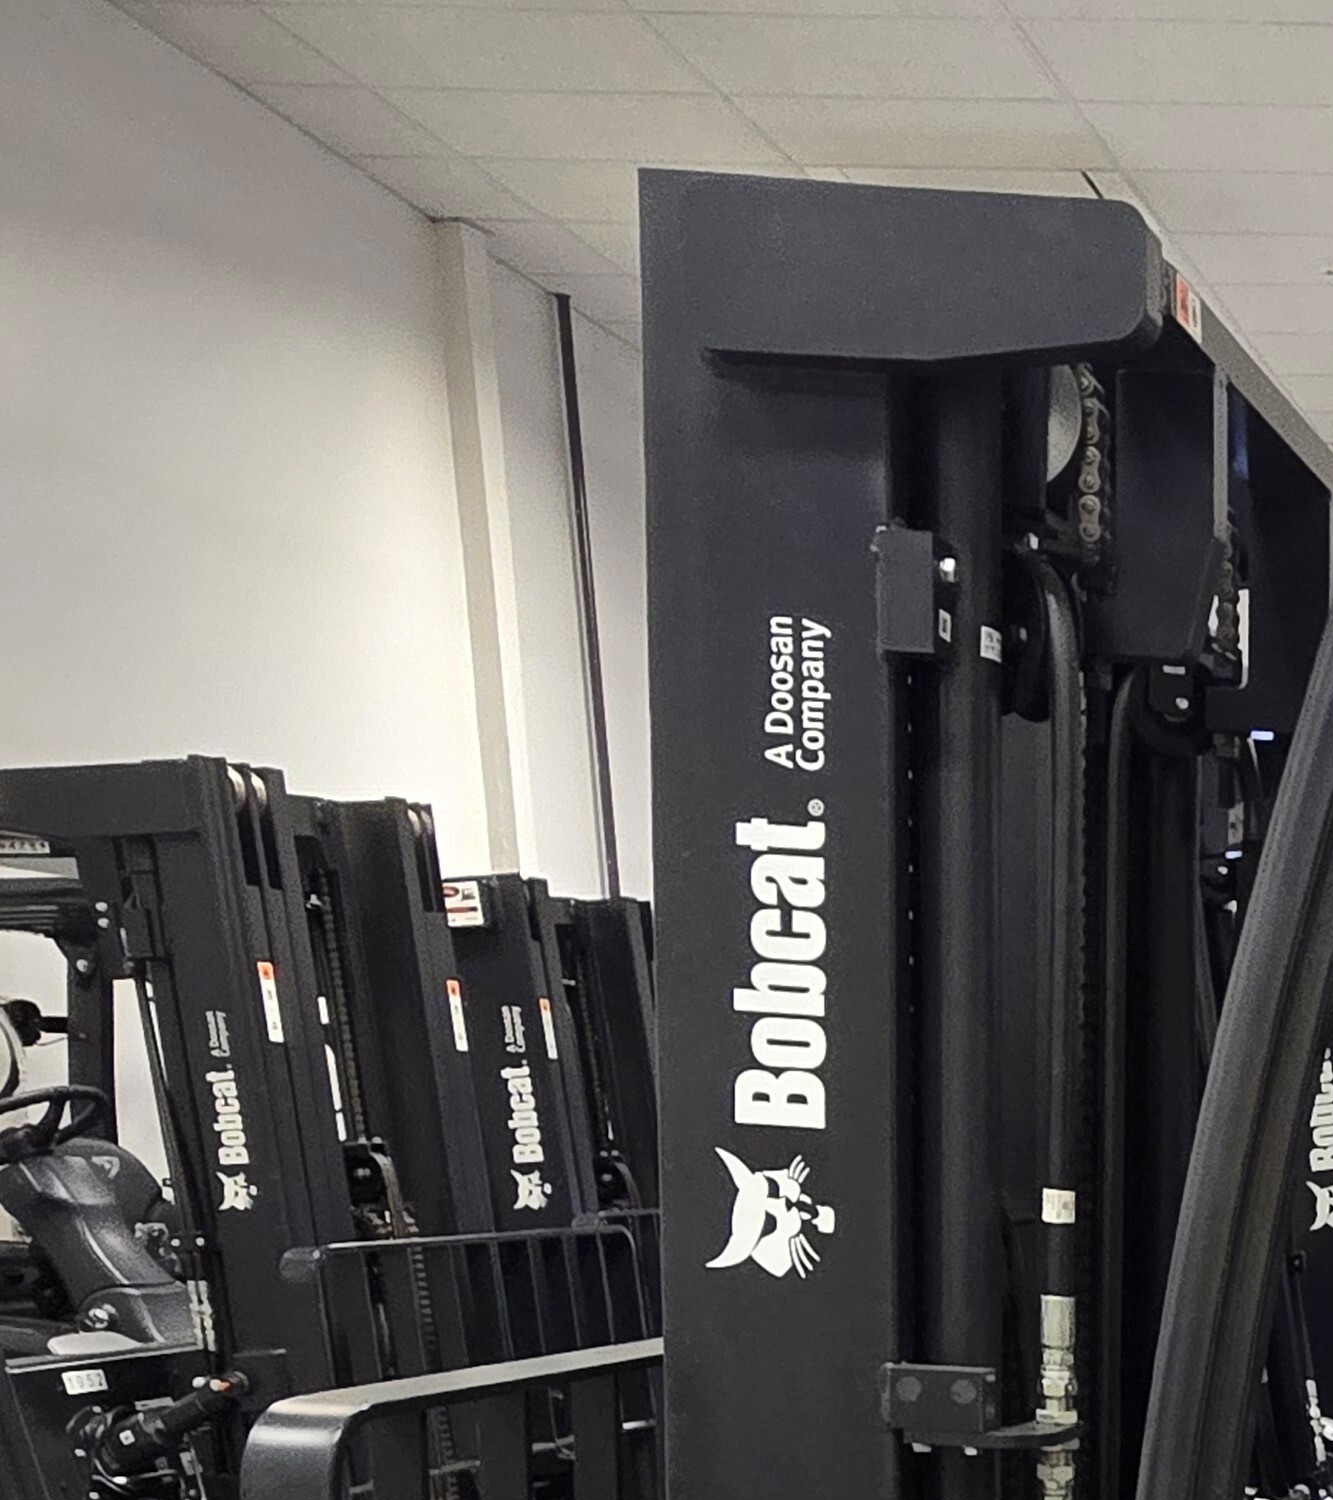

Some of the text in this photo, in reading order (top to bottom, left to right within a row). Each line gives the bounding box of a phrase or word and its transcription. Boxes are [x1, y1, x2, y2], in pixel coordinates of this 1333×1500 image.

[763, 616, 795, 769] A Doosan
[795, 617, 832, 772] Company
[732, 817, 828, 1130] Bobcat
[205, 1069, 251, 1166] Bobcat
[500, 1066, 545, 1164] Bobcat
